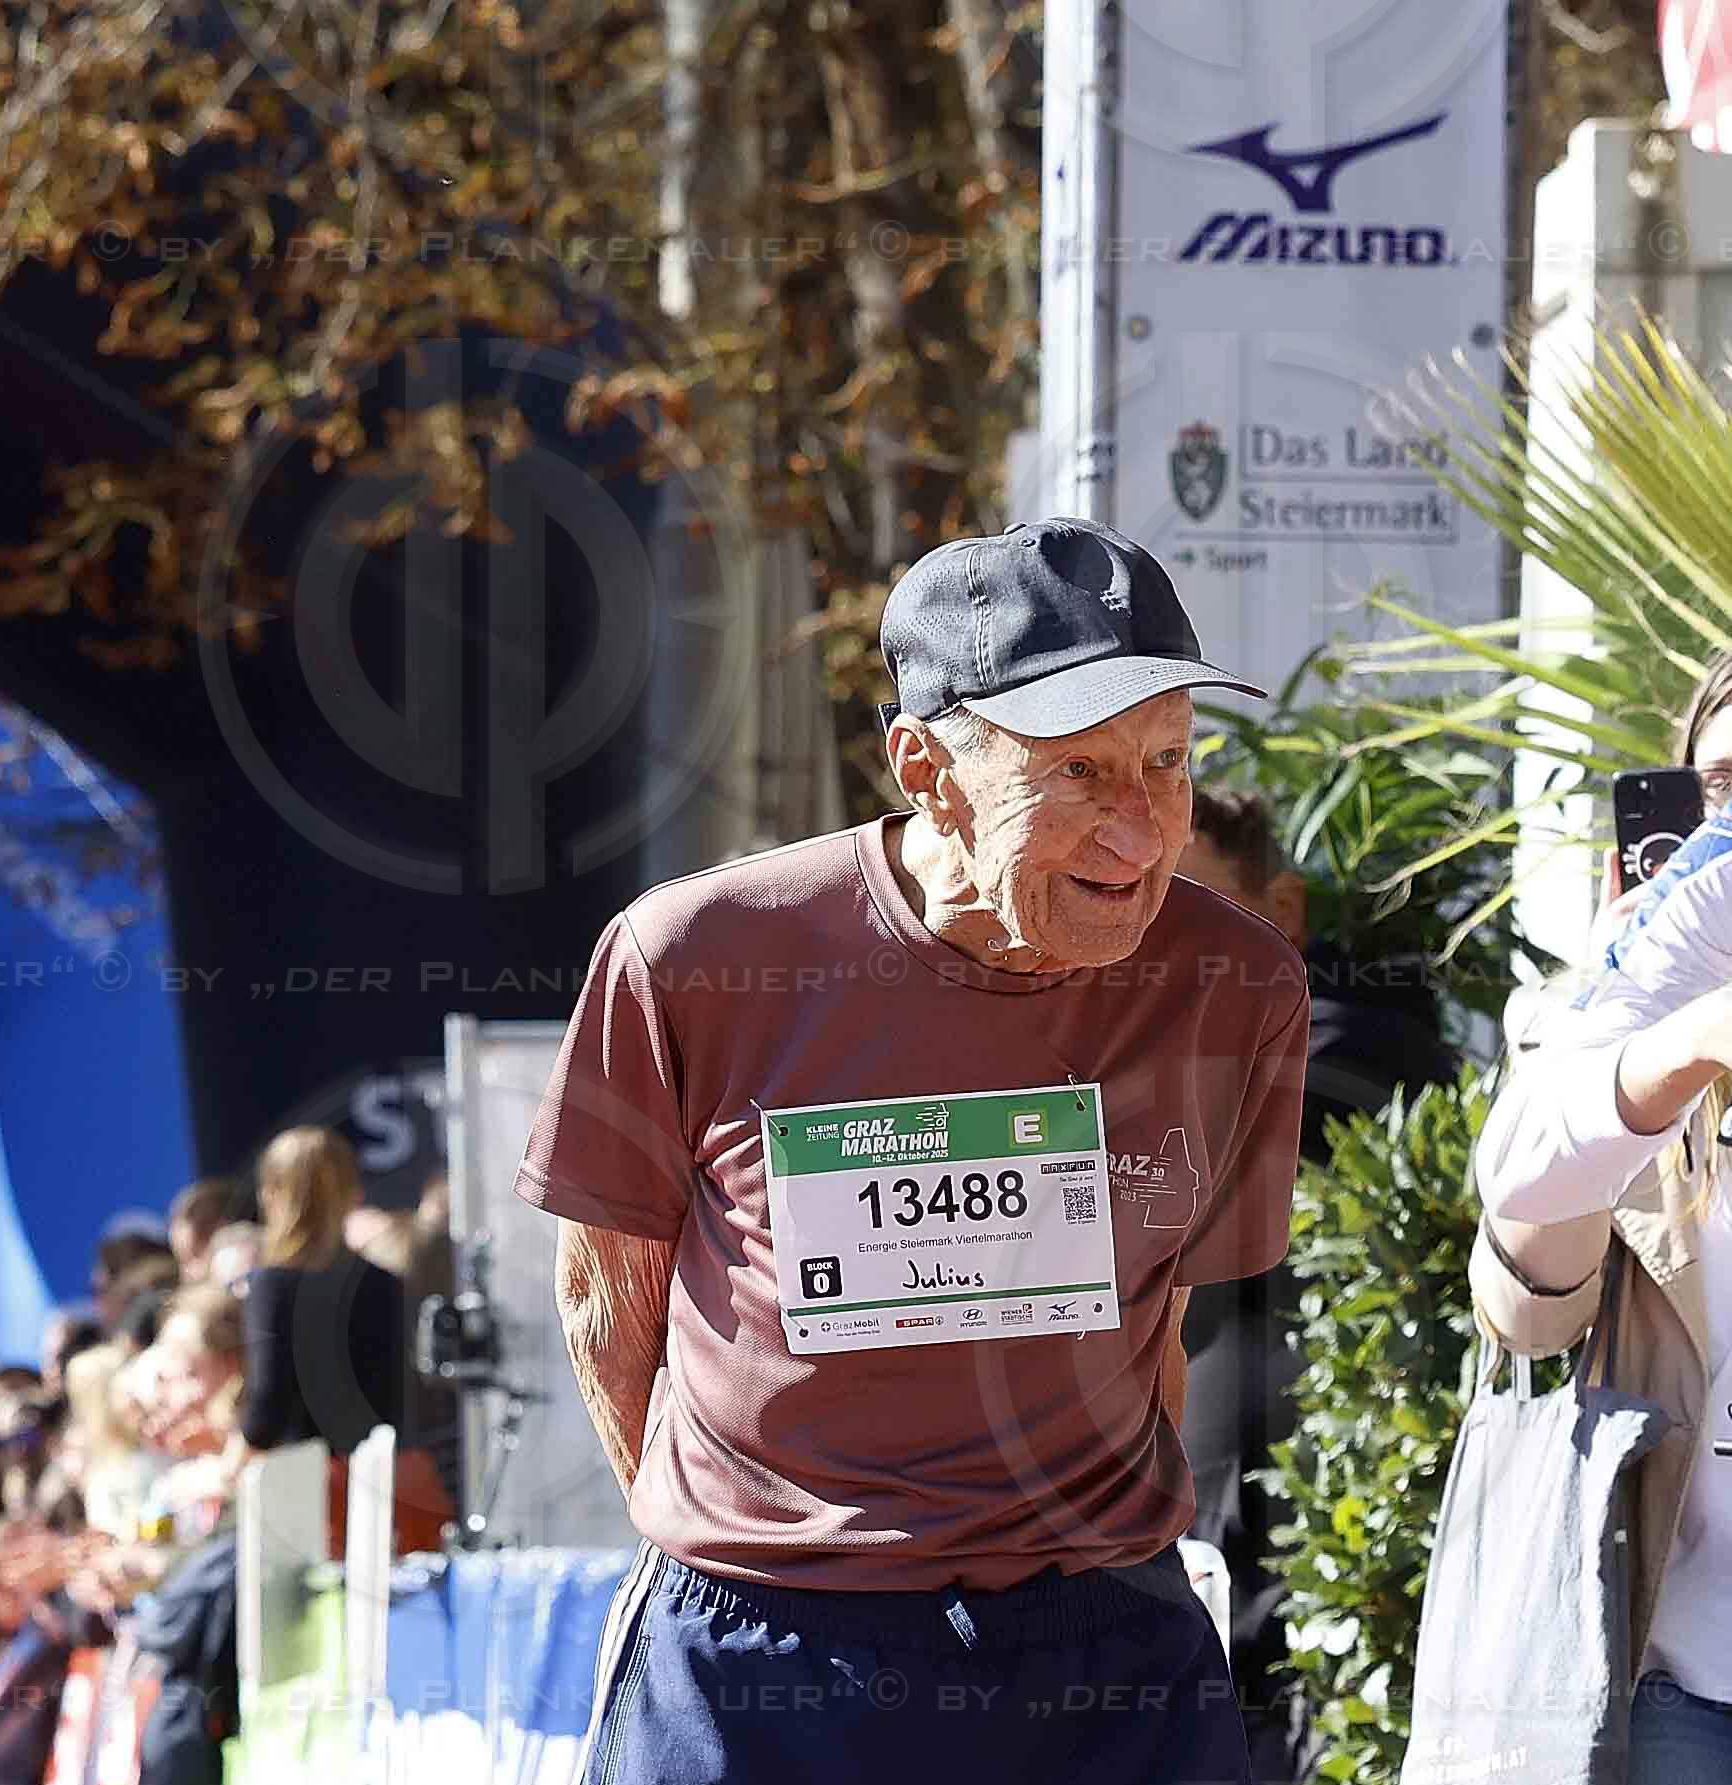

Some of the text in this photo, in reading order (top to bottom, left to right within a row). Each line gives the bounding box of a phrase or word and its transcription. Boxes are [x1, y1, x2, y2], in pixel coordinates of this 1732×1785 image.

[1177, 211, 1448, 268] MIZUNO
[1251, 424, 1329, 467] Das
[1240, 489, 1453, 529] Steiermark
[806, 1123, 839, 1135] KLEINE
[806, 1132, 840, 1142] ZEITUNG
[843, 1118, 895, 1139] GRAZ
[841, 1130, 949, 1157] MARATHON
[898, 1151, 929, 1162] Oktober
[858, 1169, 1028, 1230] 13488
[858, 1229, 1033, 1254] Energie Steiermark Viertelmarathon
[806, 1260, 834, 1272] BLOCK
[902, 1259, 985, 1290] Julius
[813, 1272, 830, 1294] 0
